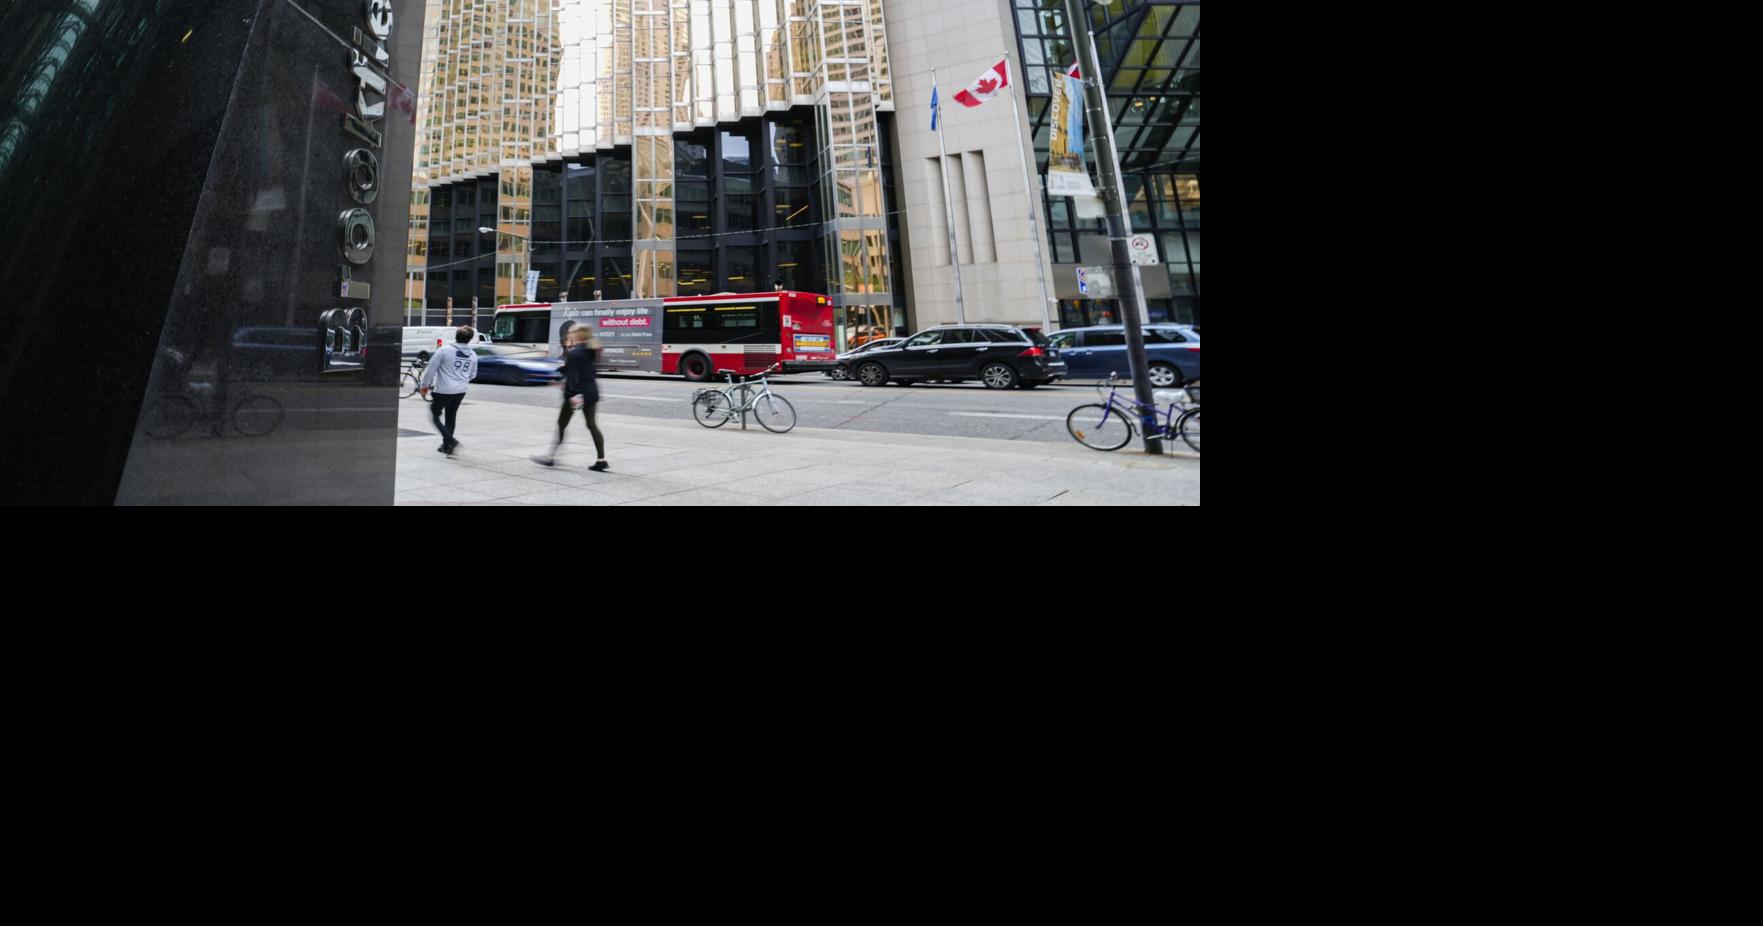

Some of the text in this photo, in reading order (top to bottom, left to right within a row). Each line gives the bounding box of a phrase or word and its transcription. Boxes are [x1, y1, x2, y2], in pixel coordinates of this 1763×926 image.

[1050, 80, 1063, 140] DISCOVER
[593, 308, 615, 318] finally
[615, 308, 636, 317] enjoy
[636, 307, 649, 315] life
[601, 318, 649, 326] without debt.
[453, 360, 471, 372] 98
